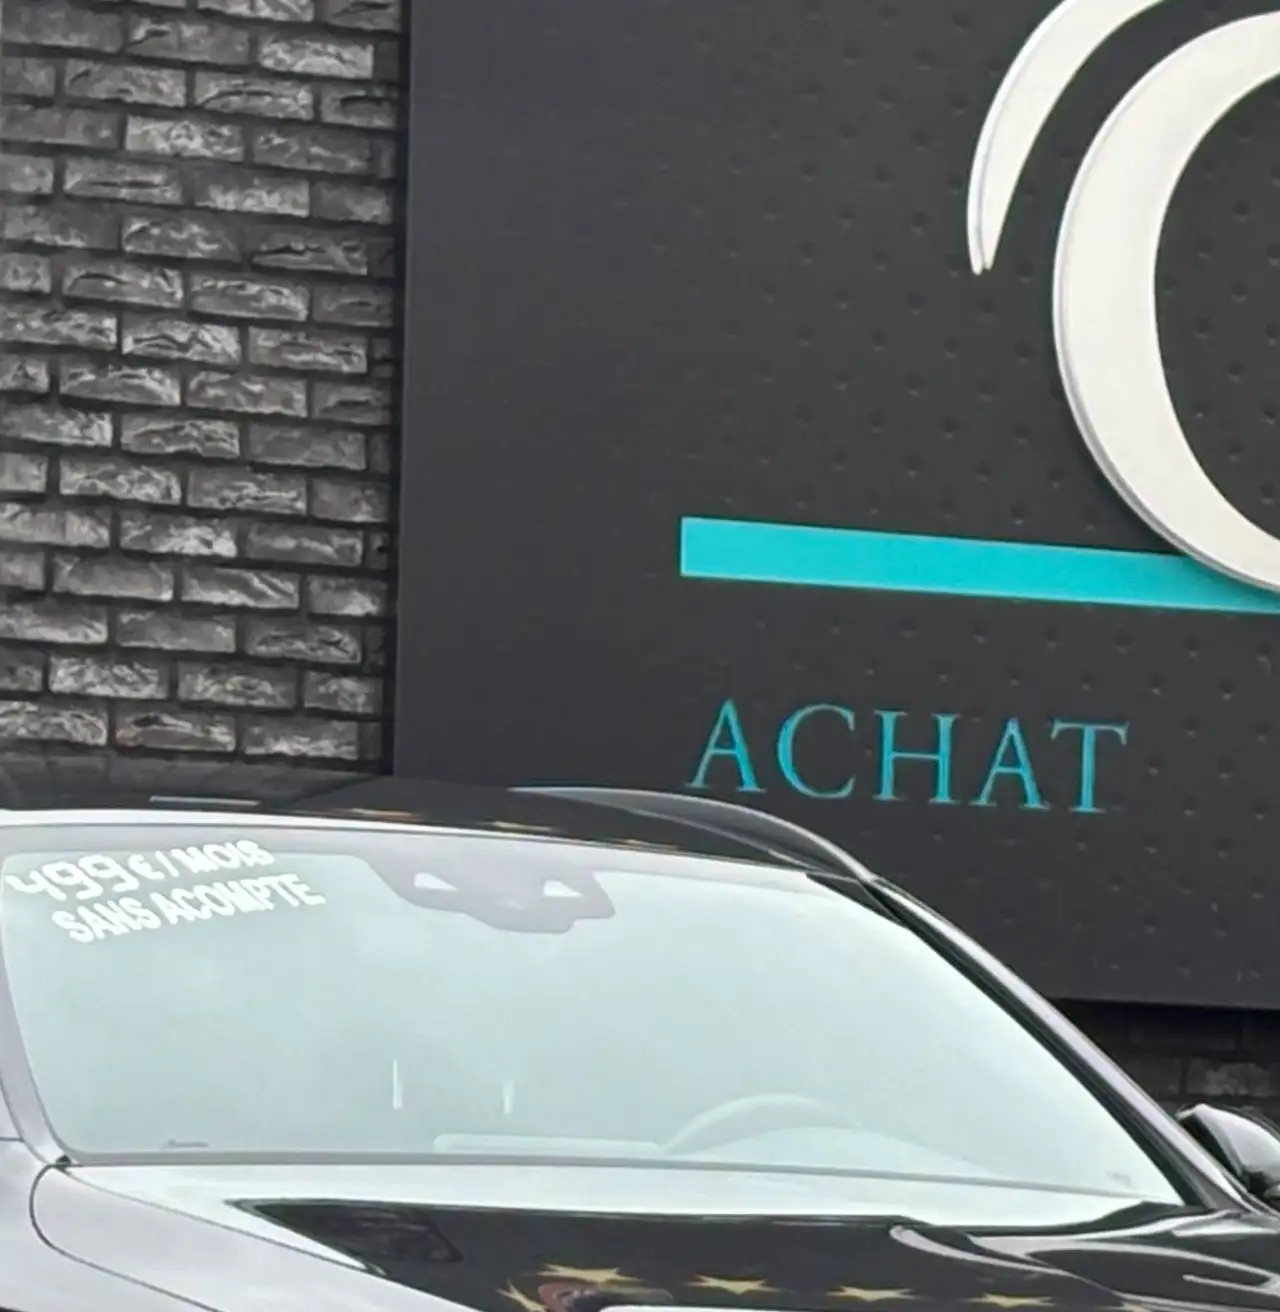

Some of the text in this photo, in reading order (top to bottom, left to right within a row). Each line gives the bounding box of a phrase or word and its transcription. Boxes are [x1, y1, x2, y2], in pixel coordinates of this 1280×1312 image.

[688, 697, 1130, 815] ACHAT
[52, 873, 327, 943] SANS ACOMPTE
